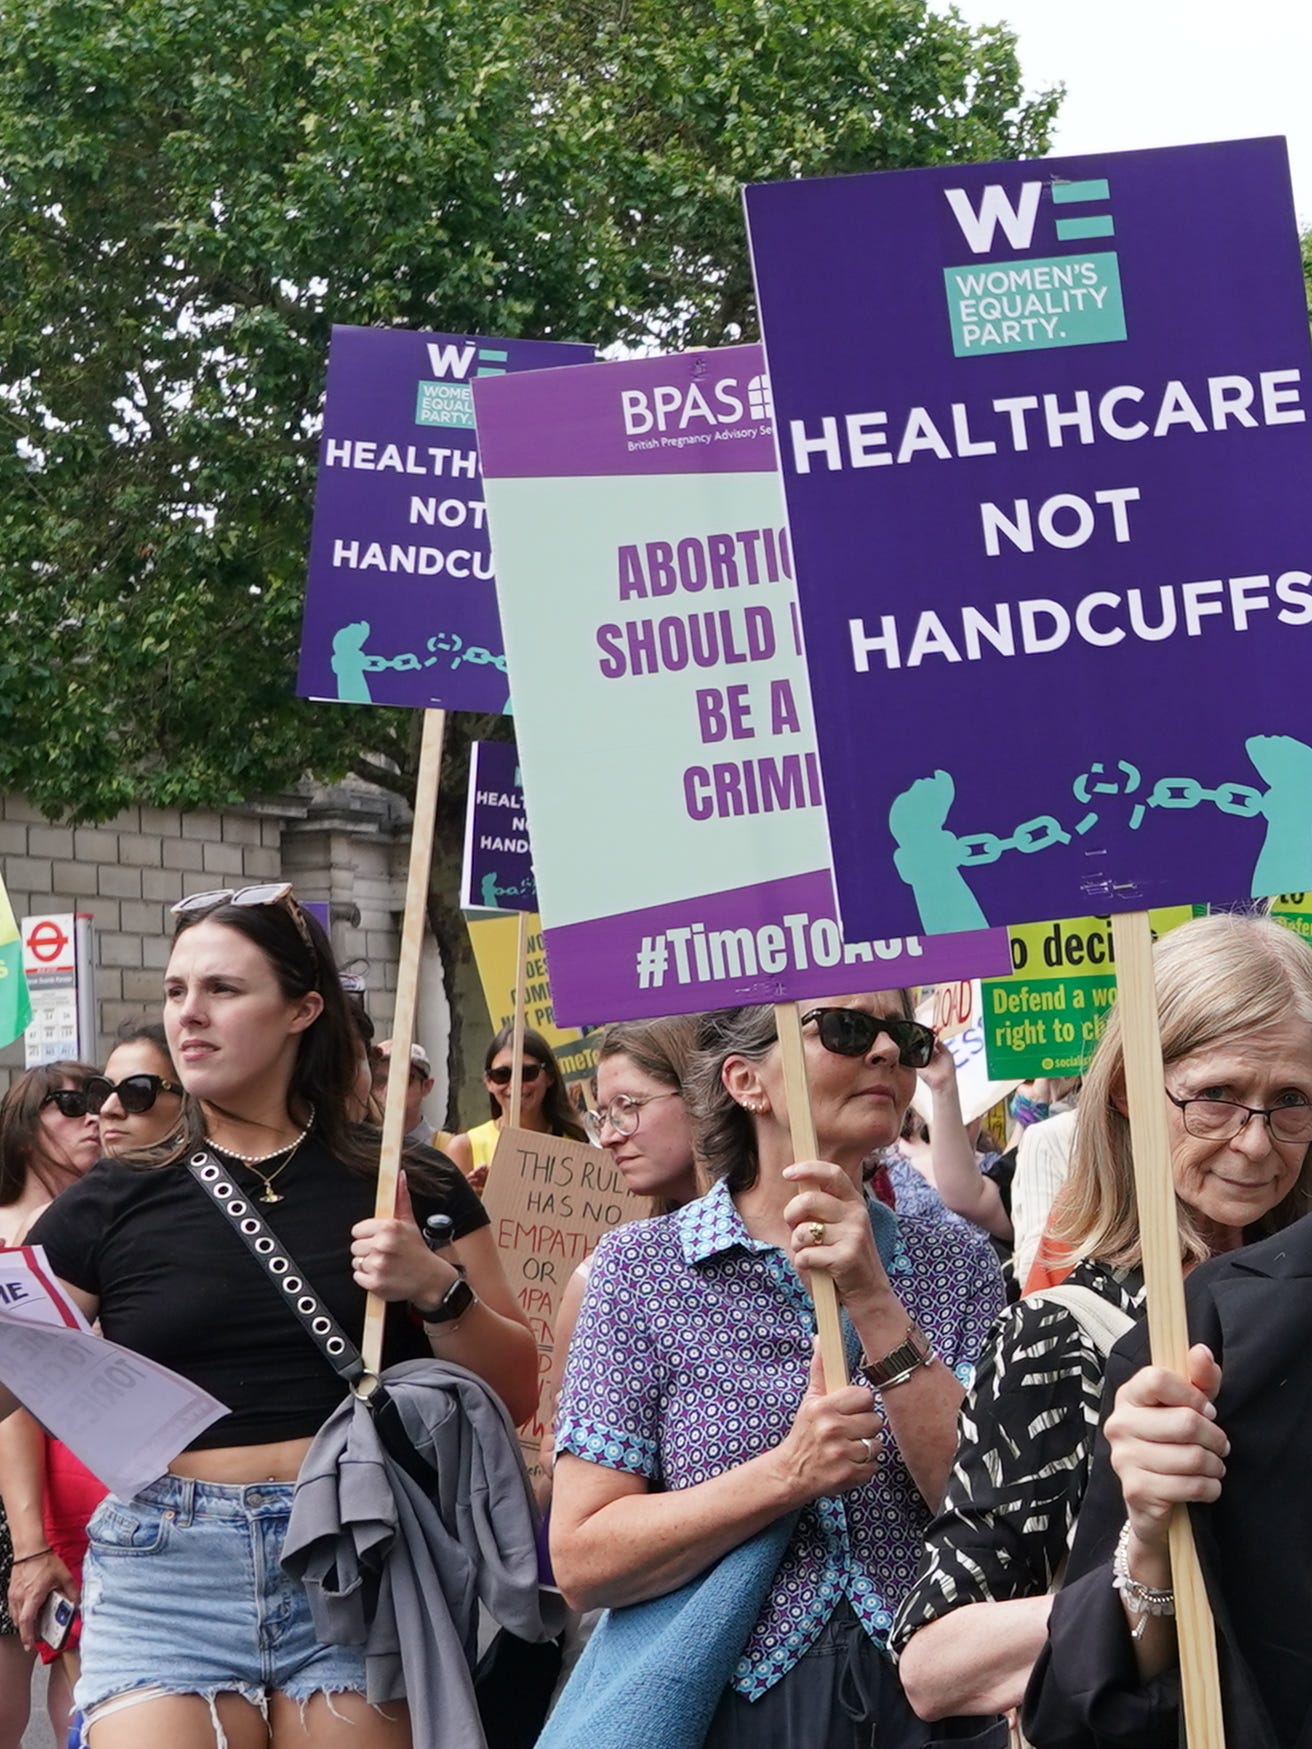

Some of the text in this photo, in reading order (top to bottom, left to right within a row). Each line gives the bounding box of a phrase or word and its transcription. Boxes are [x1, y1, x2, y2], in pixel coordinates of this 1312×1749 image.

[955, 263, 1099, 299] WOMEN'S
[959, 286, 1108, 322] EQUALITY
[963, 317, 1067, 347] PARTY.
[420, 409, 473, 425] PARTY.
[621, 378, 744, 436] BPAS
[790, 368, 1307, 474] HEALTHCARE
[627, 438, 660, 452] British
[661, 434, 712, 449] Pregnancy
[714, 427, 757, 442] Advisory
[325, 438, 483, 479] HEALTH
[409, 495, 487, 530] NOT
[980, 487, 1141, 557] NOT
[332, 539, 496, 581] HANDCU
[596, 605, 777, 679] SHOULD
[696, 678, 801, 744] BE A
[992, 984, 1066, 1014] Defend
[1072, 989, 1085, 1009] a
[995, 1019, 1046, 1051] right
[1053, 1019, 1075, 1042] to
[517, 1149, 637, 1198] THIS RUL
[527, 1191, 622, 1226] HAS NO
[498, 1218, 600, 1260] EMPATH
[522, 1257, 557, 1286] OR
